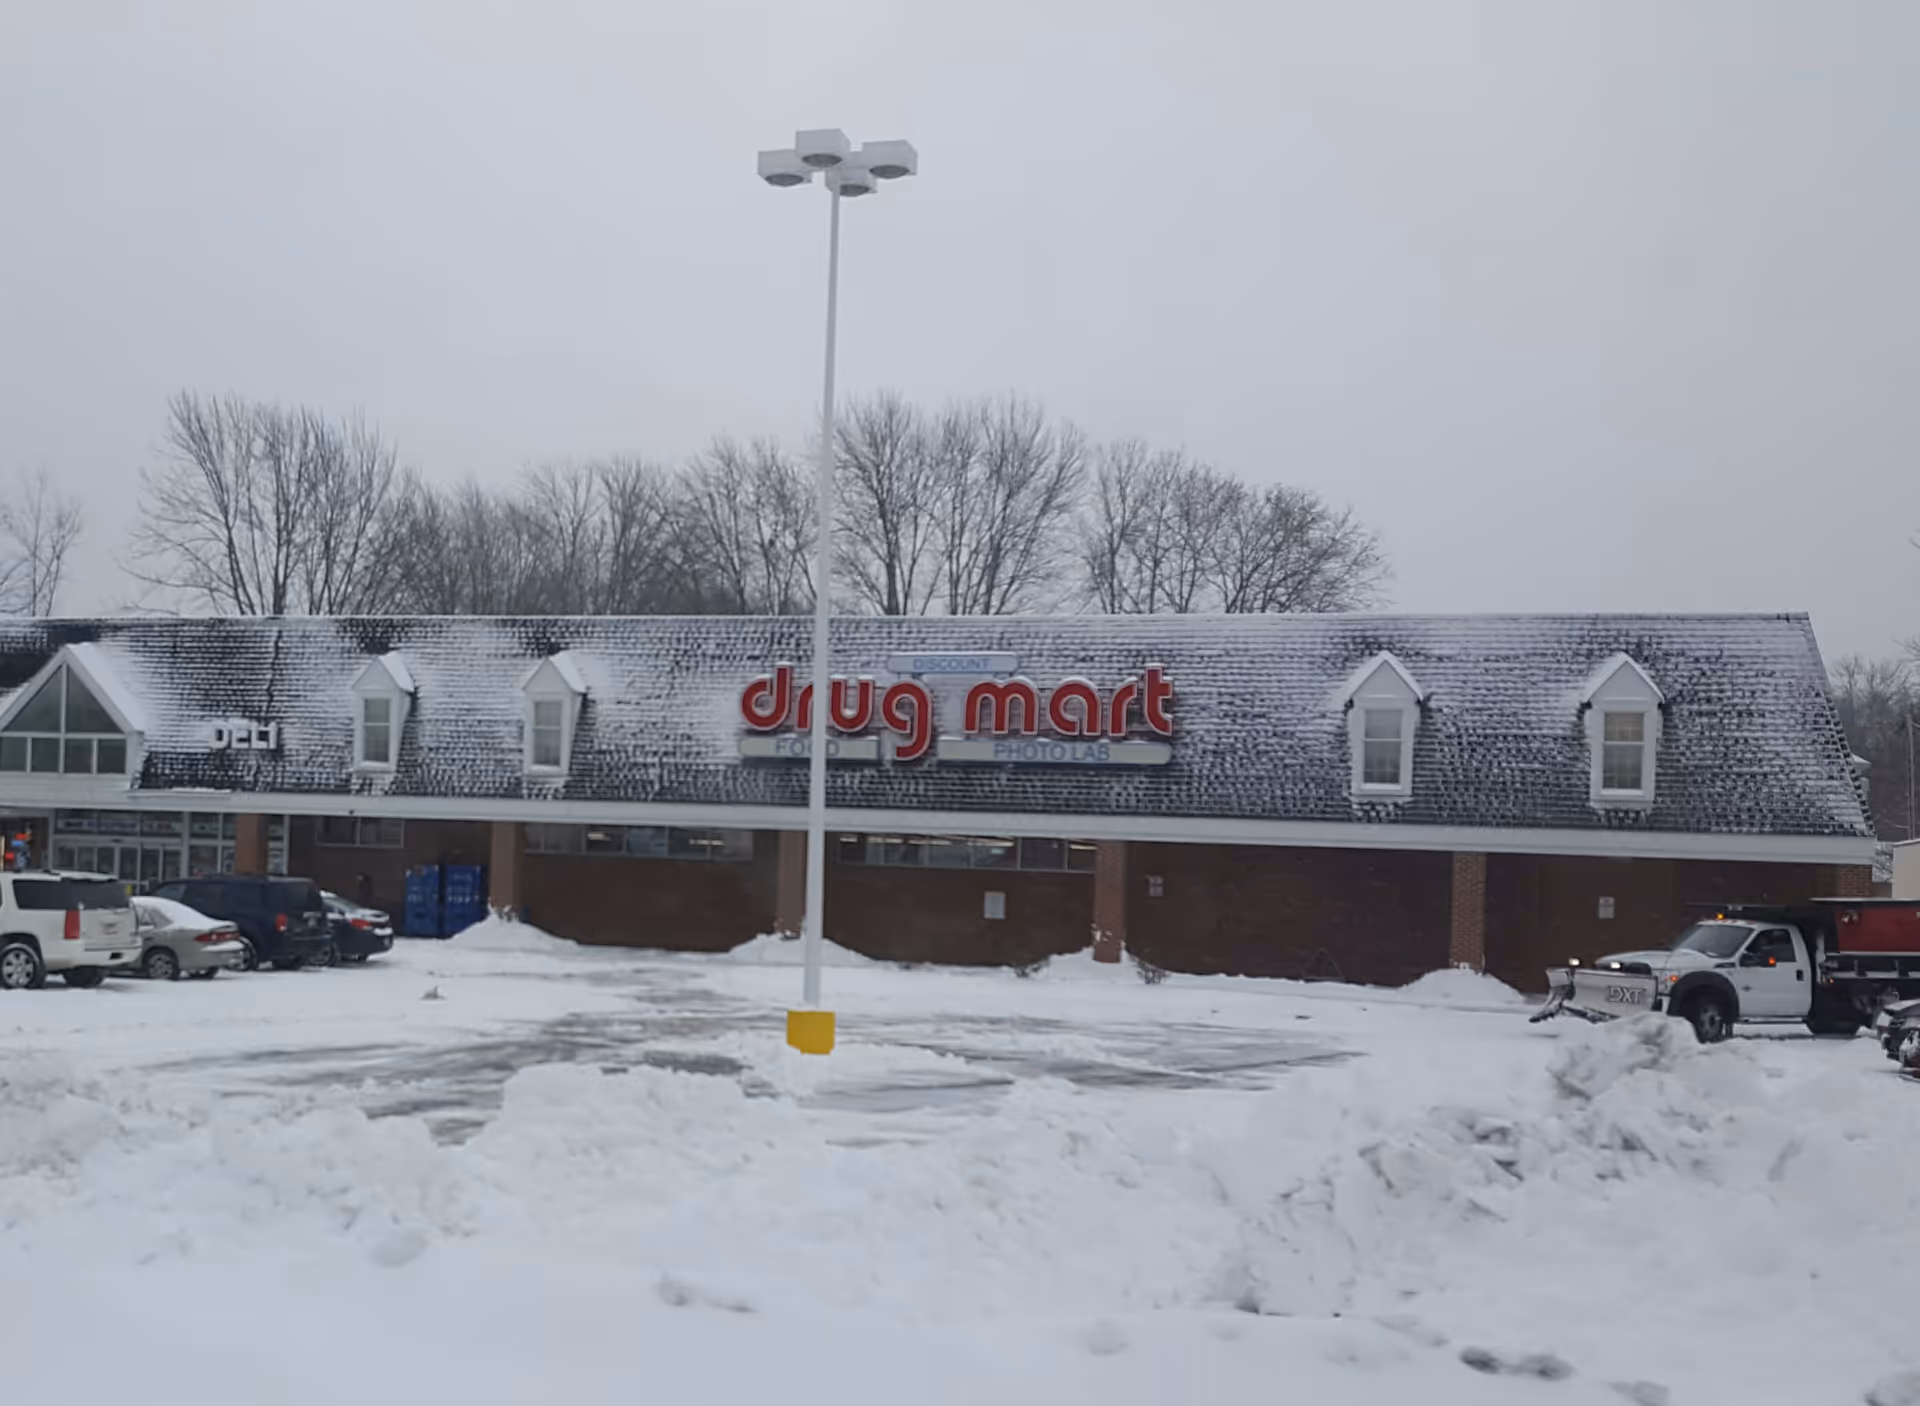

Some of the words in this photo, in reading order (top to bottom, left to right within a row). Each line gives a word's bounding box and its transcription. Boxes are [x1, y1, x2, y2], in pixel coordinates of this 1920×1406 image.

[912, 657, 991, 671] DISCOUNT
[741, 665, 932, 761] drug
[963, 664, 1173, 737] mart
[209, 719, 278, 749] DELI
[775, 738, 840, 757] FOD
[994, 741, 1067, 761] PHOTO
[1072, 742, 1111, 762] LAB
